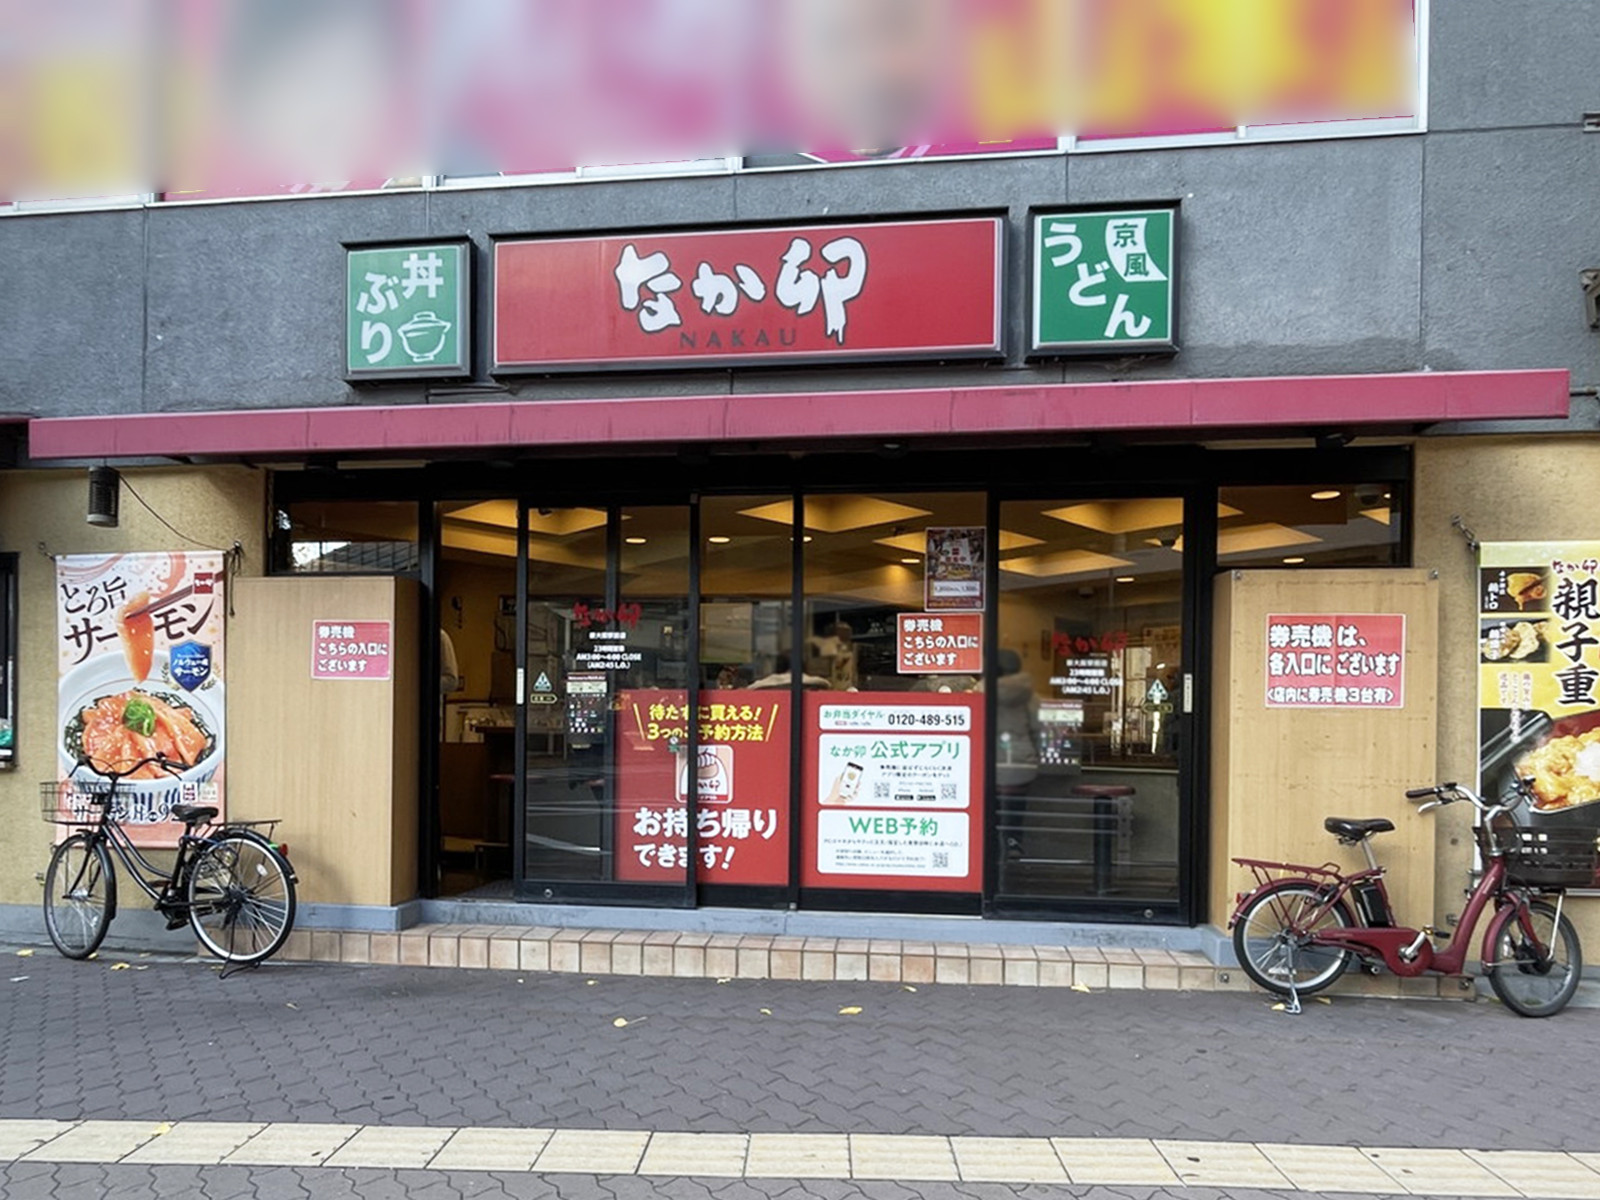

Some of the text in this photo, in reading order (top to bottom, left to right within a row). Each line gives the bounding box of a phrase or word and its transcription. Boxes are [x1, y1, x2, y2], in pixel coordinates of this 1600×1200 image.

[1112, 222, 1149, 277] 京風
[615, 237, 867, 345] なか卯
[1044, 222, 1152, 338] うどん
[680, 327, 796, 349] NAKAU
[1553, 560, 1598, 574] なか卯
[61, 576, 127, 615] とろ旨
[64, 598, 215, 664] サーモン
[903, 618, 943, 633] 券売機
[1269, 624, 1367, 648] 券売機は、
[318, 642, 388, 656] こちらの入口に
[904, 635, 979, 649] こちらの入口に
[1552, 578, 1600, 704] 親子重
[318, 659, 367, 672] ございます
[904, 652, 958, 666] ございます
[1269, 652, 1400, 676] 各入口にございます
[823, 709, 965, 726] お弁当ダイヤル 0120-489-515
[830, 740, 960, 759] なか卯 公式アプリ
[633, 807, 777, 840] お持ち帰り
[849, 816, 939, 837] WEB予約
